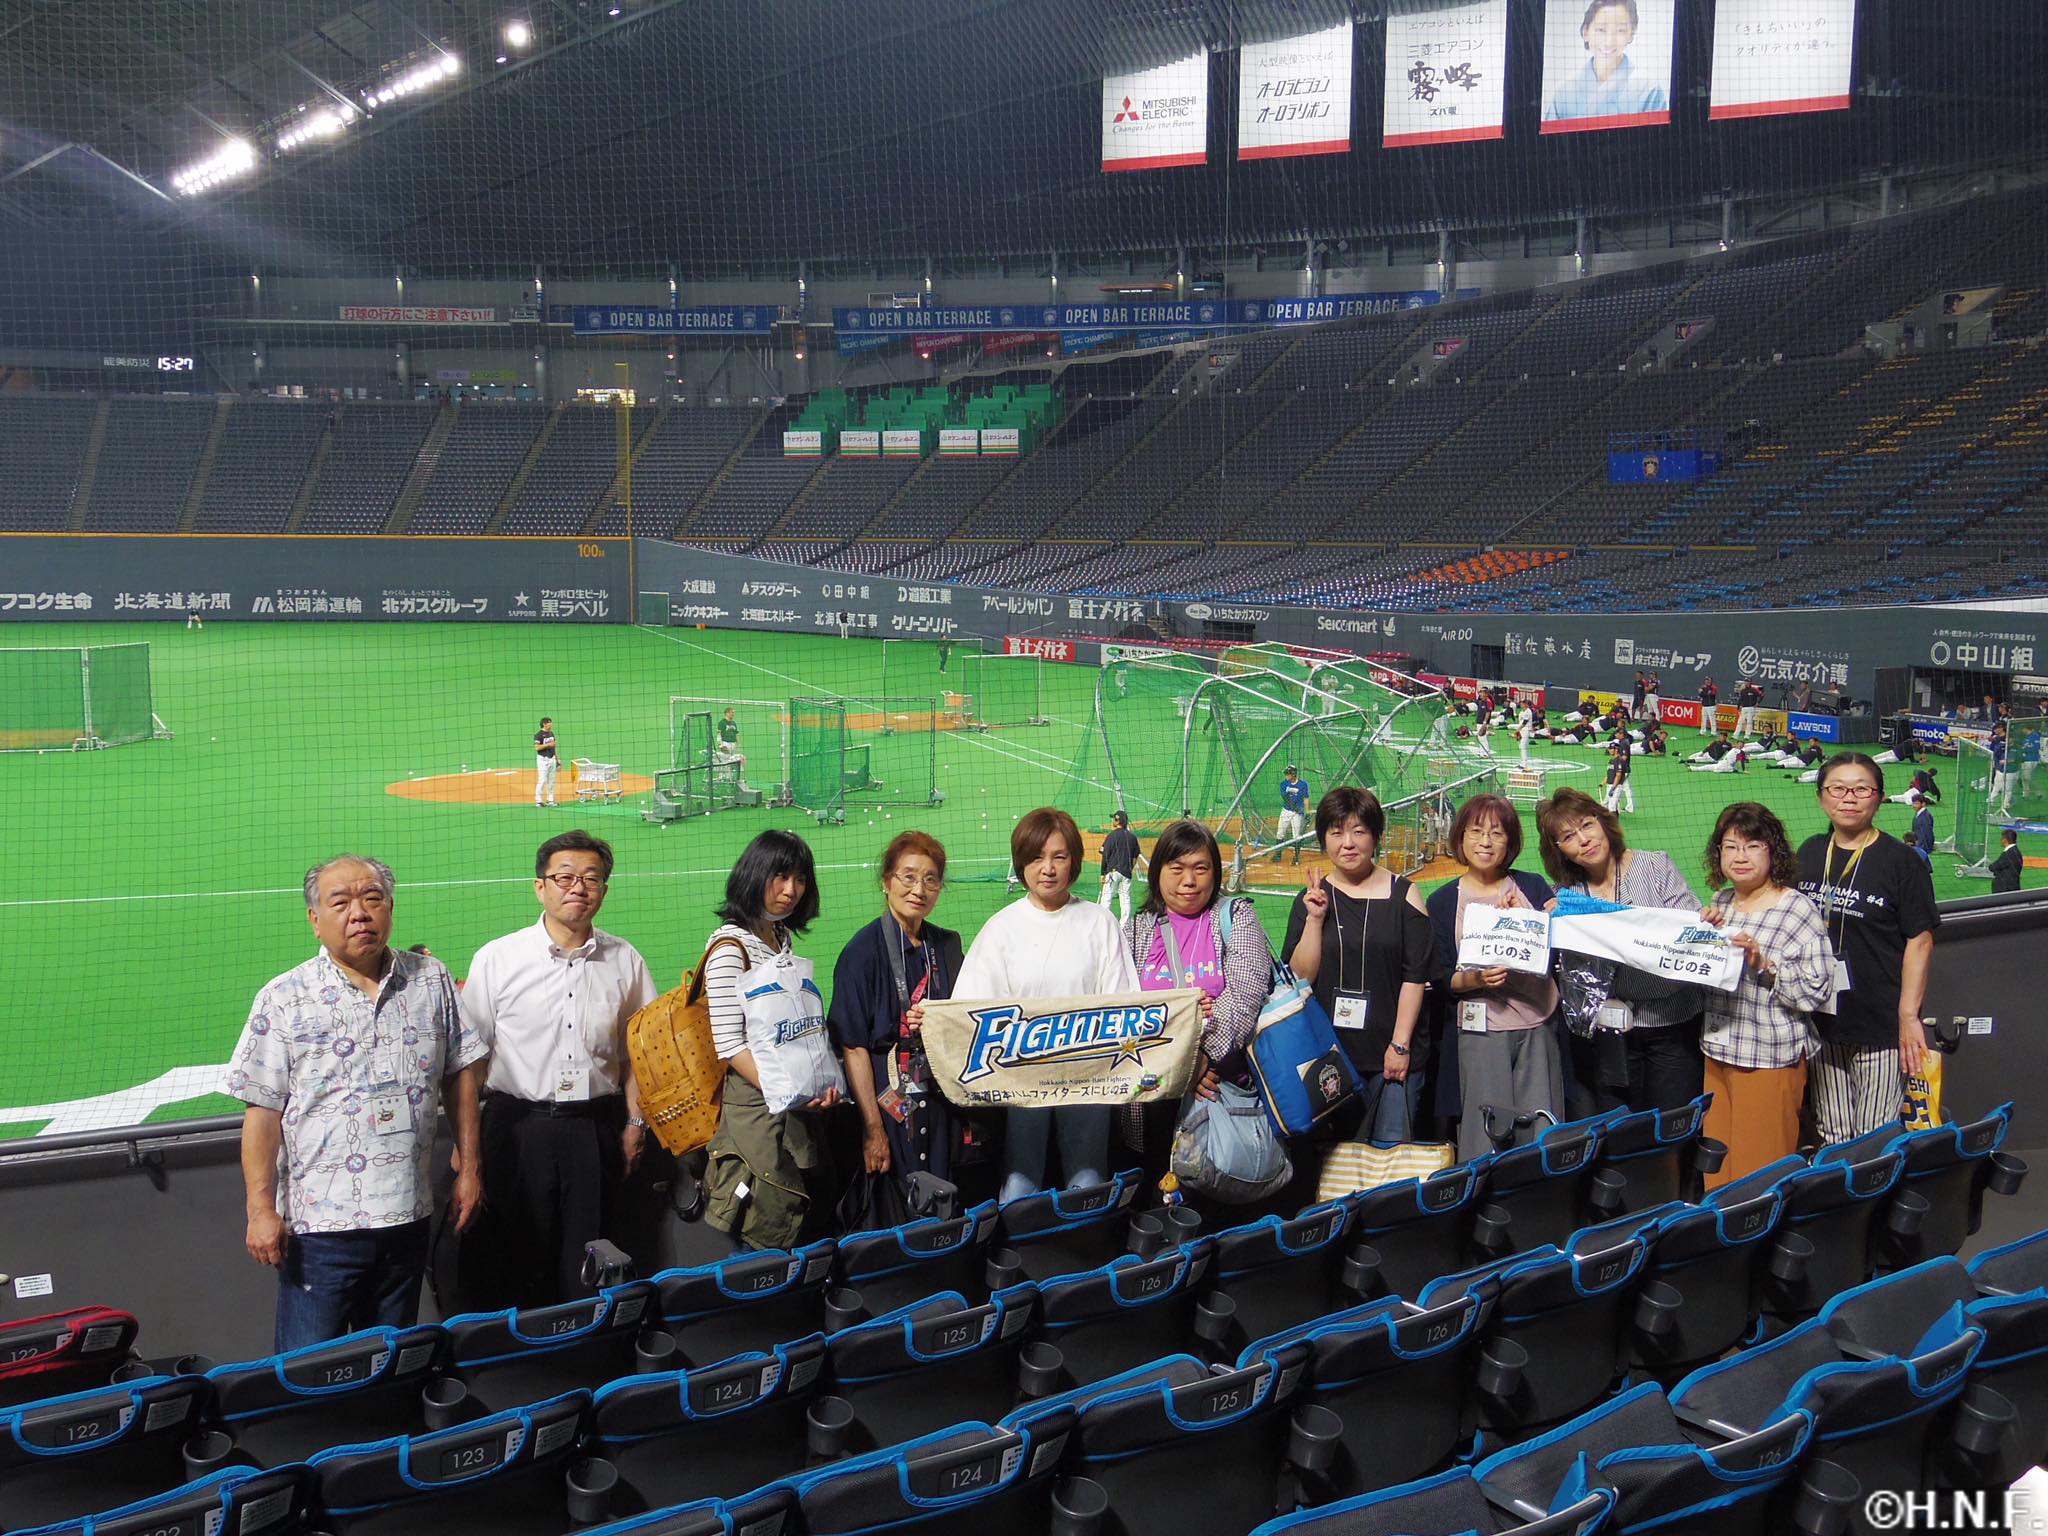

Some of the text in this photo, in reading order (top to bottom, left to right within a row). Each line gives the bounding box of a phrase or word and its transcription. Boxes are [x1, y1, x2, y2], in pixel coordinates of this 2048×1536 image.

[1407, 39, 1485, 59] 三菱エアコン
[1256, 79, 1331, 98] オーロラビジョン
[1142, 96, 1197, 111] MITSUBISHI
[1256, 101, 1330, 123] オーロラリボン
[1142, 107, 1190, 120] ELECTRIC
[1112, 124, 1143, 135] Changes
[1172, 118, 1195, 128] Better
[869, 310, 992, 327] OPEN BAR TERRACE
[1065, 305, 1191, 324] OPEN BAR TERRACE
[1267, 299, 1400, 320] OPEN BAR TERRACE
[610, 312, 734, 327] OPEN BAR TERRACE
[157, 357, 194, 371] 15:27
[540, 589, 609, 599] サッポロ生ビール
[683, 579, 716, 594] 大成建設
[834, 584, 870, 599] 田中組
[1, 592, 93, 610] フコク生命
[114, 592, 231, 610] 北海道新聞
[277, 597, 363, 613] 松岡満運輸
[382, 598, 488, 614] 北ガスグループ
[540, 599, 609, 617] 黒ラベル
[981, 596, 1054, 616] アベールジャパン
[1068, 598, 1144, 622] 富士メガネ
[814, 611, 878, 629] 北海気工事
[1213, 608, 1270, 621] いちたかガスワン
[891, 615, 958, 634] クリーンリバー
[1317, 615, 1378, 634] Seicomart
[1441, 627, 1473, 641] AIR DO
[1008, 638, 1069, 660] 富士メガネ
[1524, 633, 1592, 660] 佐藤水産
[1956, 642, 2034, 671] 中山組
[1760, 657, 1849, 686] 元気な介護
[1660, 703, 1695, 719] J:COM
[1791, 720, 1831, 734] LAWSON
[1866, 894, 1885, 907] #4
[1481, 944, 1532, 962] にじの会
[1633, 938, 1662, 951] Hokkaido
[1662, 944, 1701, 957] Nippon-Ham
[1658, 955, 1713, 976] にじの会
[958, 1003, 1170, 1084] FIGHTERS
[1039, 1075, 1132, 1087] Hokkaido Nippon-Ham Fighters
[1561, 1150, 1576, 1164] 129
[1438, 1186, 1454, 1201] 128
[1082, 1196, 1100, 1210] 127
[932, 1235, 952, 1247] 126
[1300, 1228, 1318, 1244] 127
[1599, 1263, 1619, 1281] 127
[753, 1274, 775, 1289] 125
[1140, 1276, 1160, 1292] 126
[551, 1317, 576, 1334] 124
[1426, 1323, 1448, 1343] 126
[943, 1326, 968, 1345] 125
[325, 1366, 353, 1383] 123
[714, 1382, 742, 1401] 124
[1210, 1390, 1238, 1413] 125
[68, 1422, 101, 1441] 122
[453, 1447, 485, 1468] 123
[951, 1464, 982, 1488] 124
